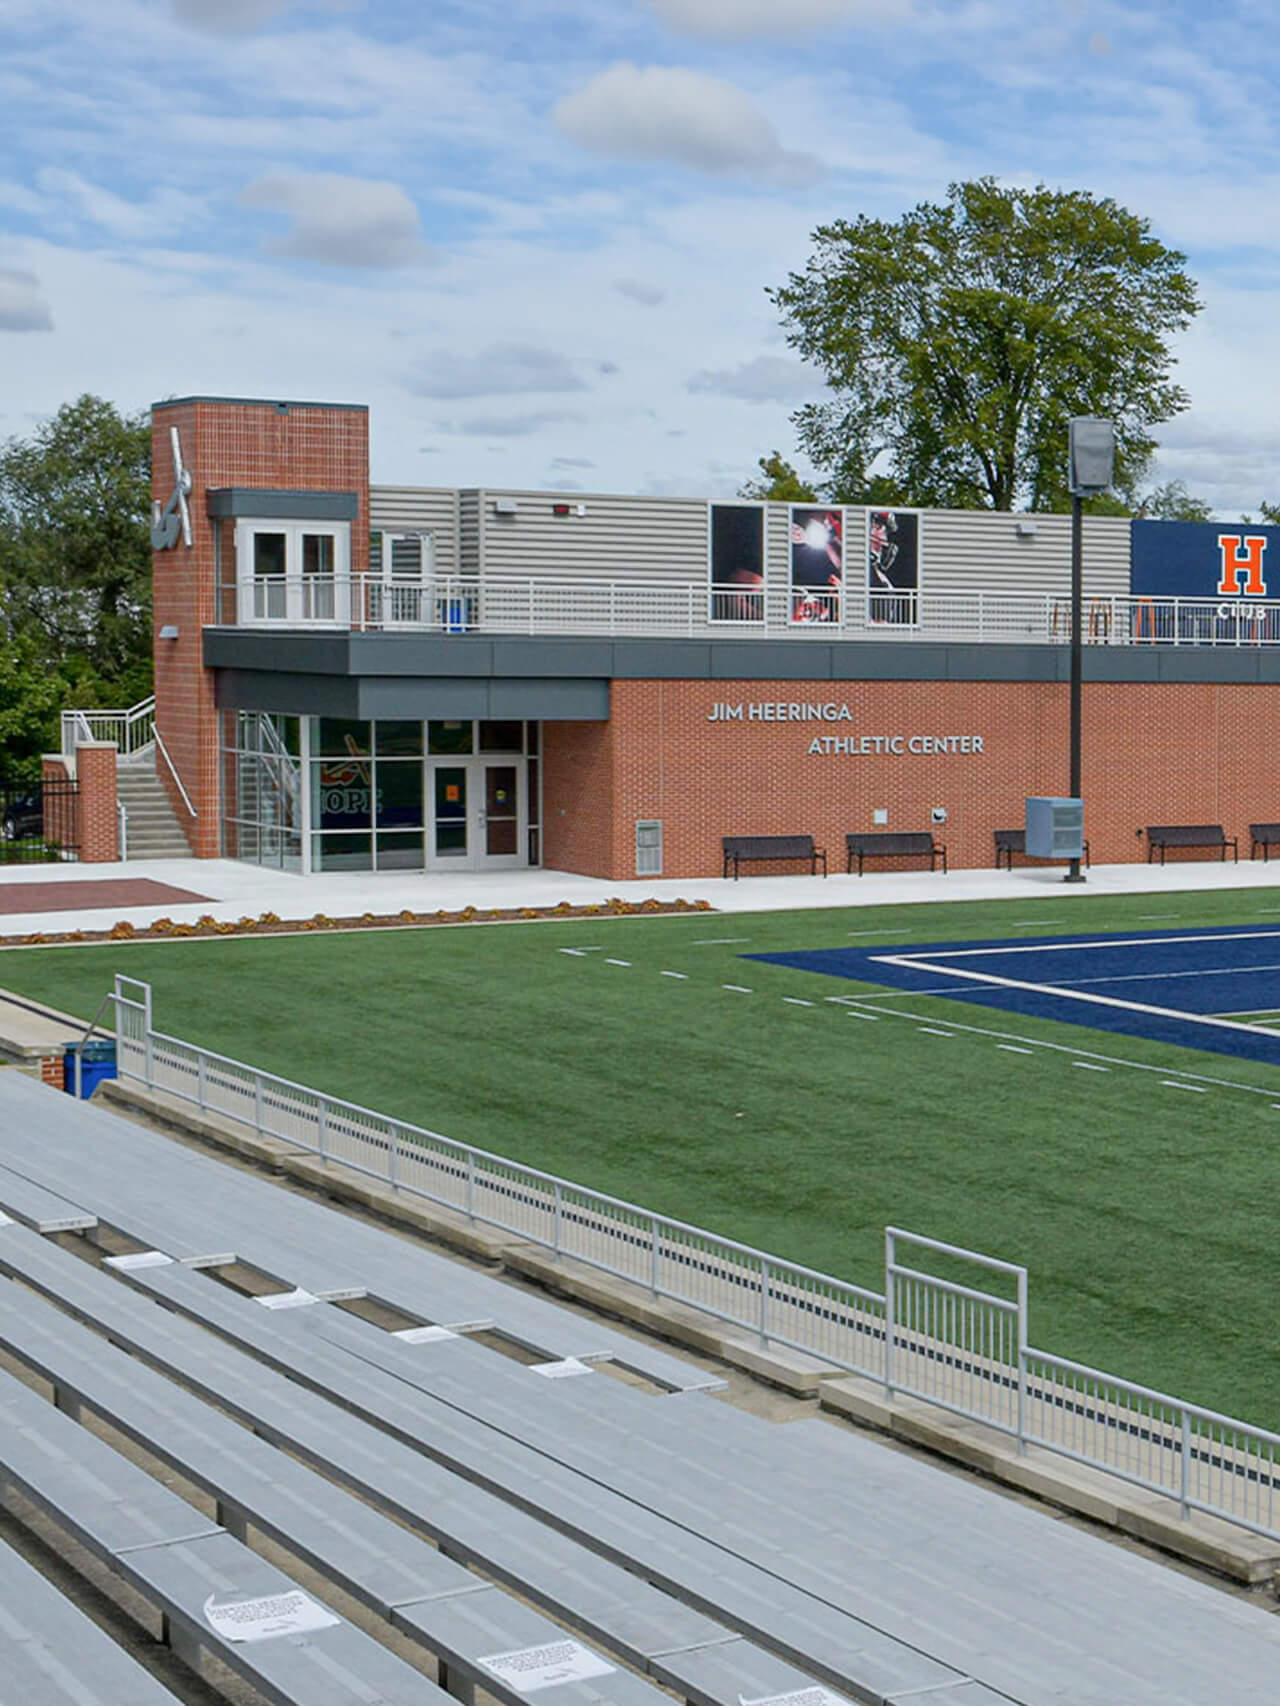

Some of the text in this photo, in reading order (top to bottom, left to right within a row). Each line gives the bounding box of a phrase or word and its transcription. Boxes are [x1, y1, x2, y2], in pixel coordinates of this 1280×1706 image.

[1217, 534, 1267, 596] H
[707, 702, 852, 721] JIM HEERINGA
[807, 735, 984, 755] ATHLETIC CENTER
